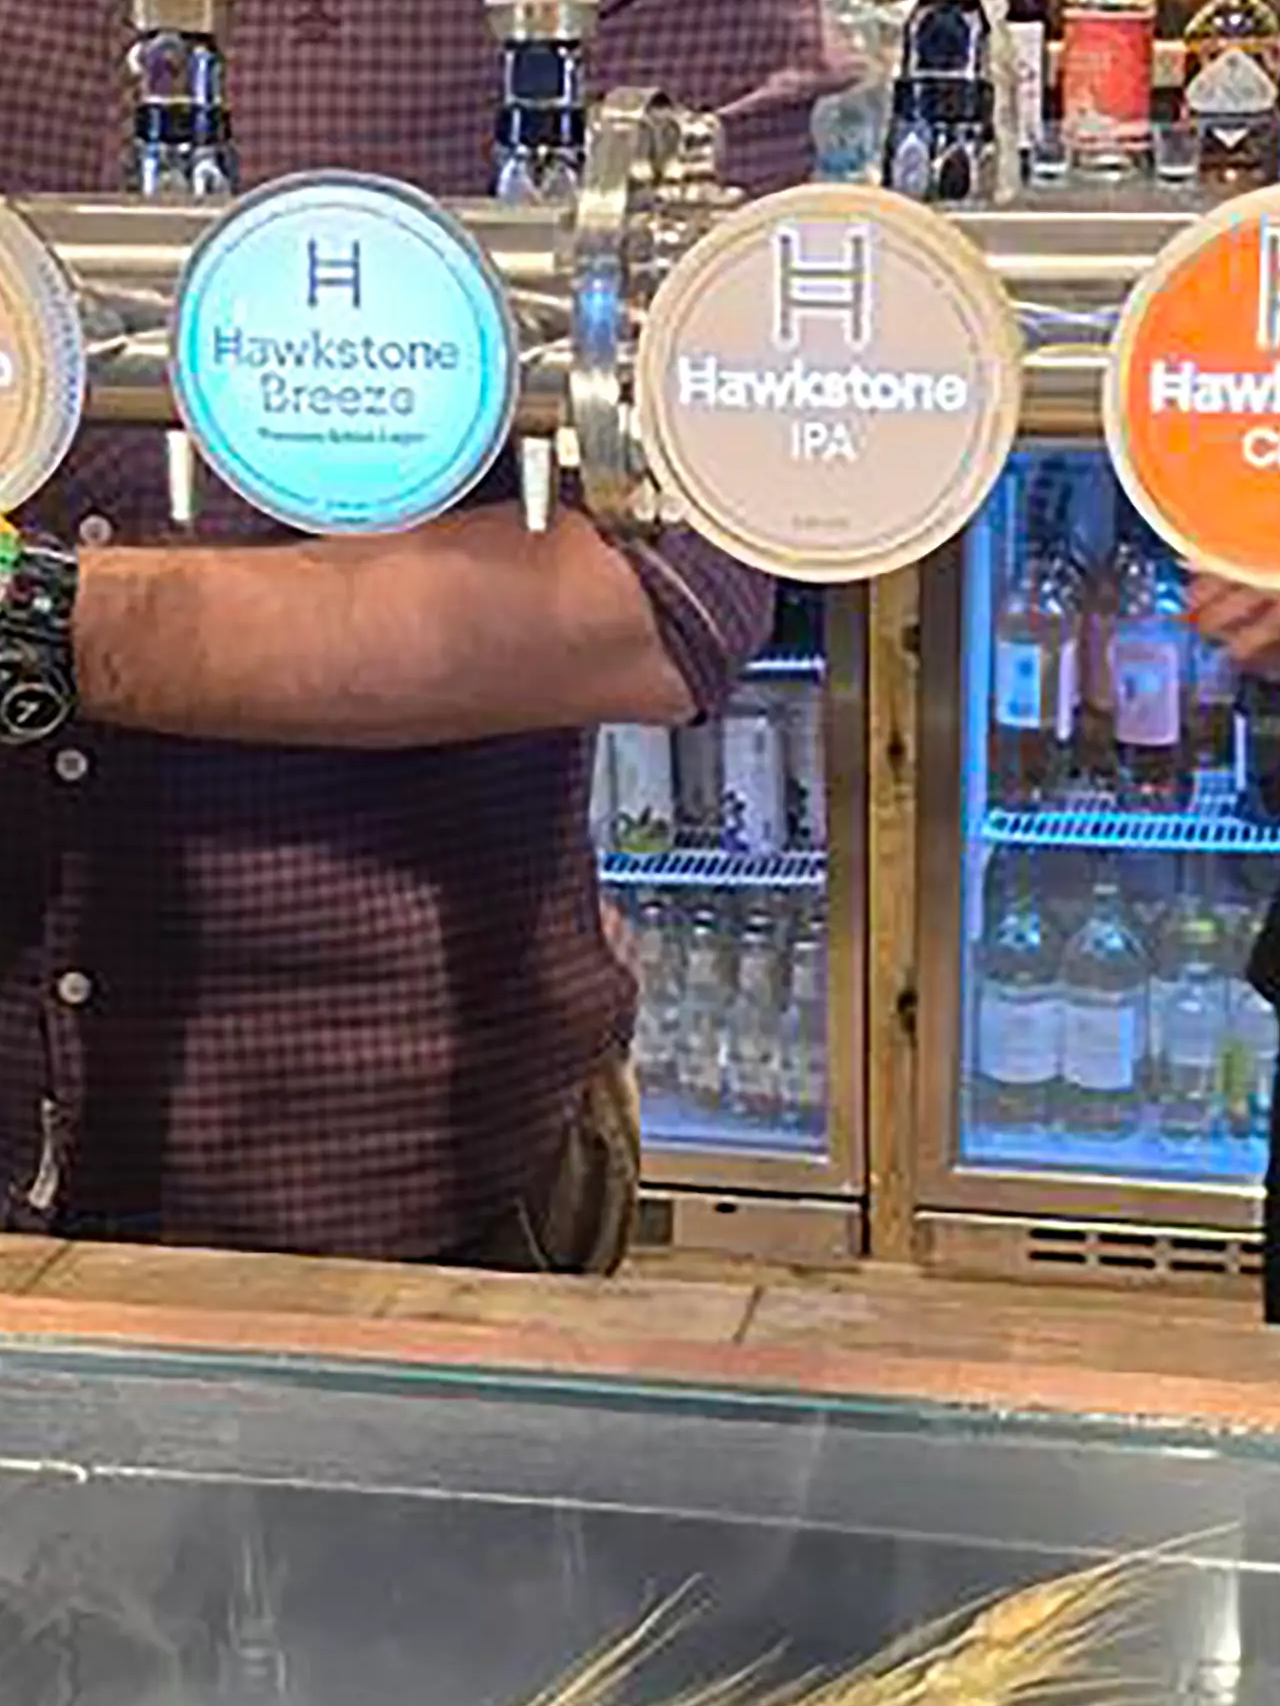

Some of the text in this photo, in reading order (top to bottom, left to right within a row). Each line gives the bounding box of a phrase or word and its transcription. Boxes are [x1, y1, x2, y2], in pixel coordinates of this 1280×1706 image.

[213, 325, 460, 370] Hawkstone
[260, 371, 415, 416] Breeze
[677, 356, 968, 411] Hawkstone
[791, 422, 857, 463] IPA
